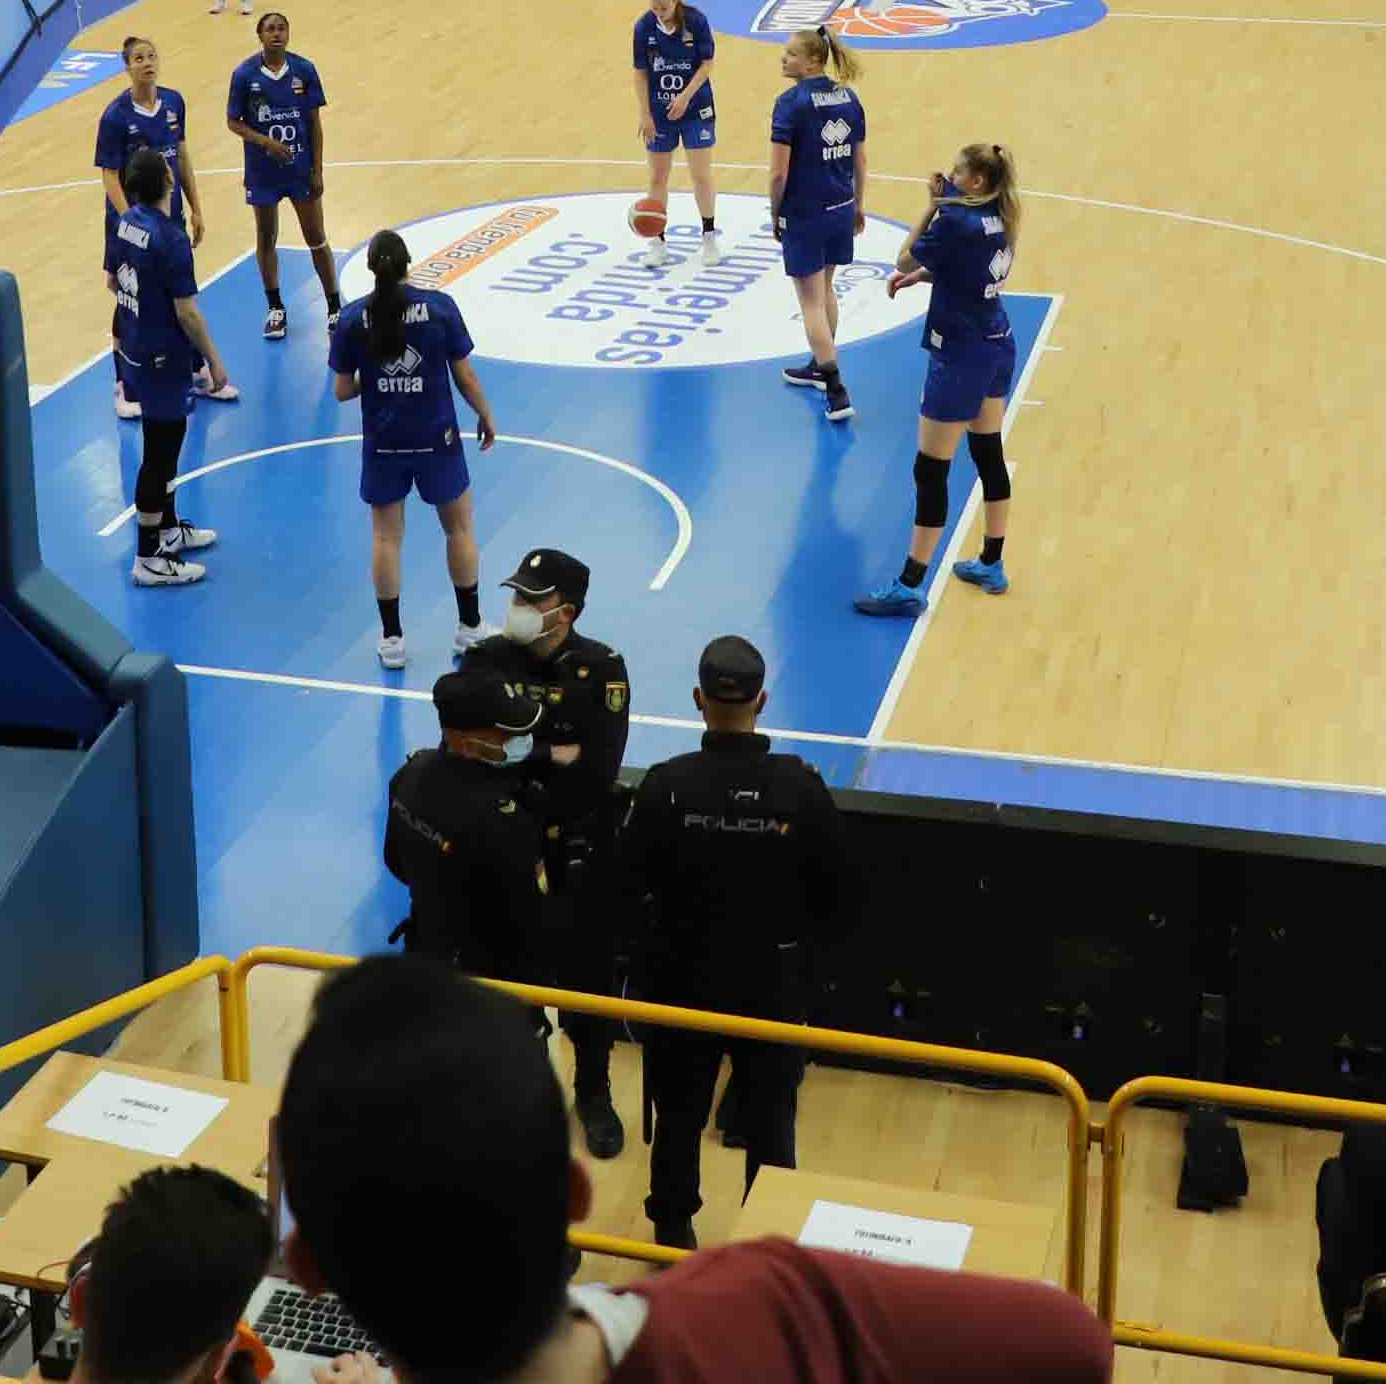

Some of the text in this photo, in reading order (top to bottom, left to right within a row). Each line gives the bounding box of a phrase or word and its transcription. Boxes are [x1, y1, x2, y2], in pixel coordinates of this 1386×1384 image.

[822, 143, 852, 161] errea
[488, 232, 611, 297] .com
[377, 375, 425, 393] errea
[684, 814, 780, 833] POLICIA
